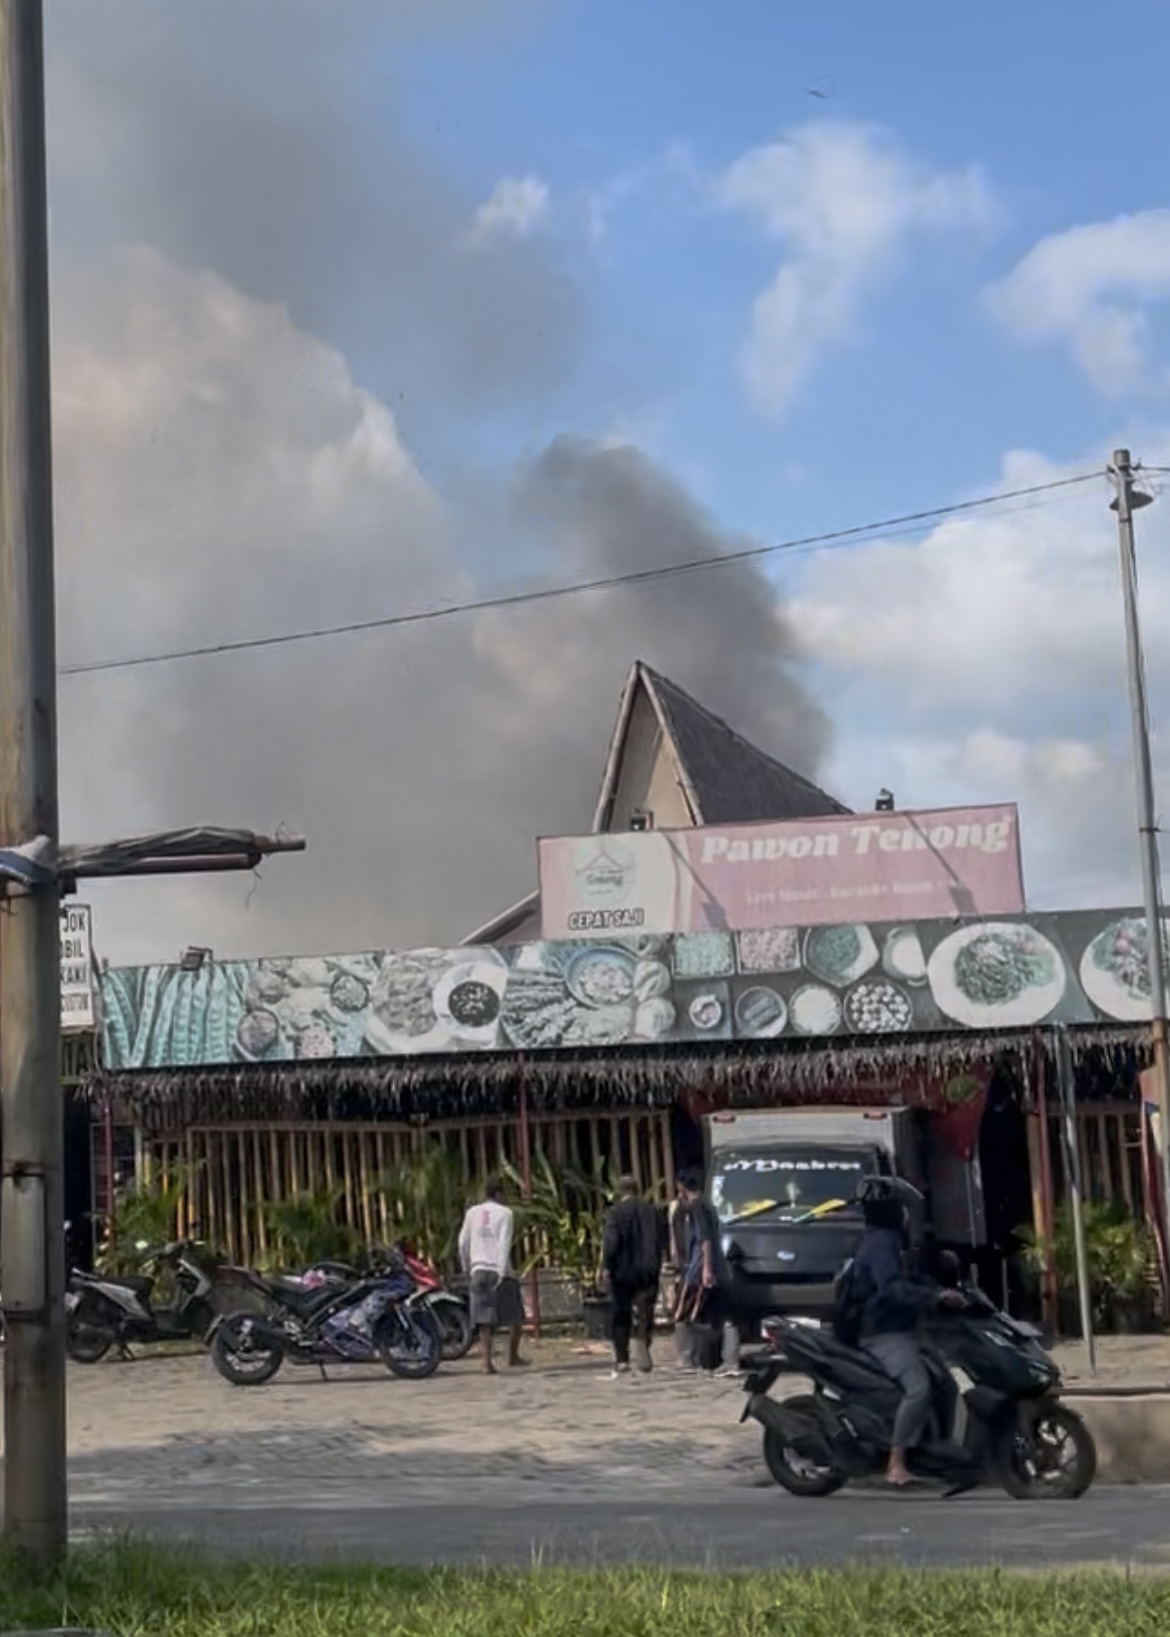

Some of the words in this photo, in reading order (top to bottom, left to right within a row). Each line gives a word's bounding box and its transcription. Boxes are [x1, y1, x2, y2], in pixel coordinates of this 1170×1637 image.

[701, 834, 839, 864] Pawon
[62, 912, 86, 933] JOK
[568, 910, 612, 931] CEPAT
[612, 907, 646, 928] SAJI
